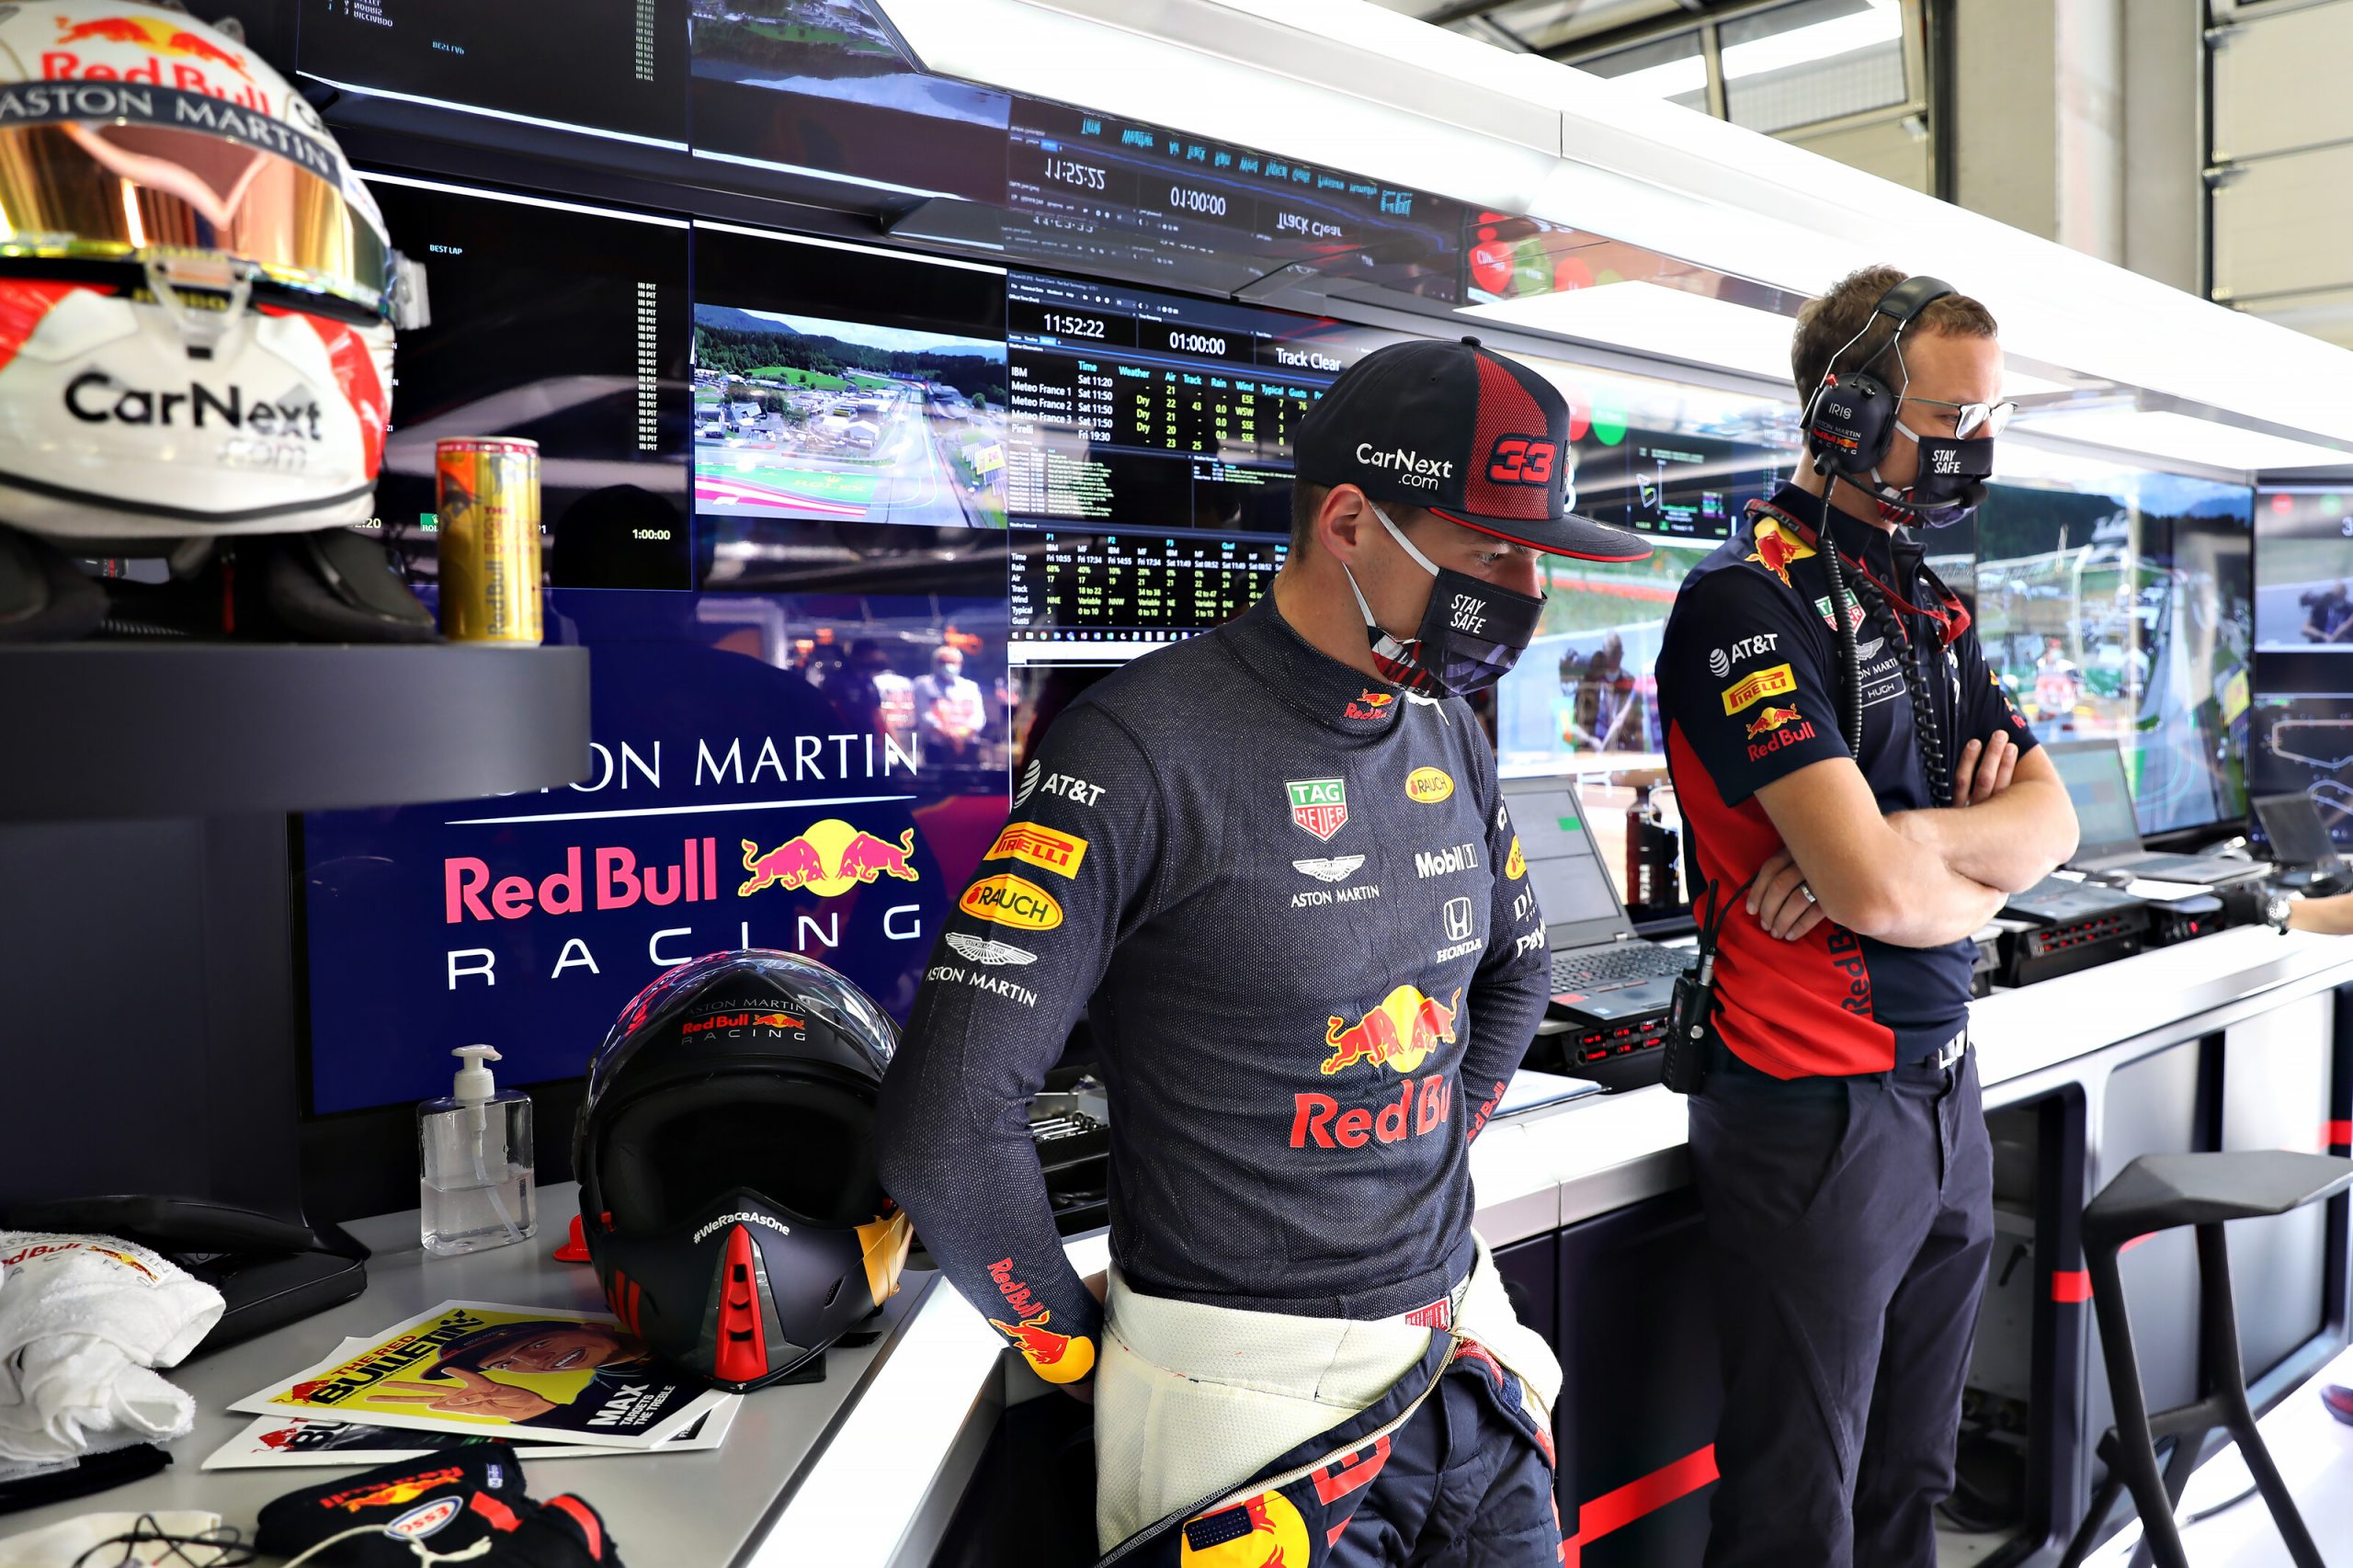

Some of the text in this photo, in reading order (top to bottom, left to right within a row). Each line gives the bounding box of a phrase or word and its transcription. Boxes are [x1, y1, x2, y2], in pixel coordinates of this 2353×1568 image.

[40, 52, 269, 117] Red Bull
[0, 89, 330, 175] ASTON MARTIN
[430, 244, 447, 253] BEST
[1044, 313, 1105, 338] 11:52:22
[1170, 332, 1225, 355] 01:00:00
[1276, 347, 1341, 371] Track Clear
[1012, 367, 1307, 410] IBM Sat 11:20 21 ESE 7 76
[1078, 361, 1307, 398] Time Weather Air Track Rain Wind Typical Gusts
[64, 372, 322, 442] CarNext
[1012, 381, 1038, 392] Meteo
[1040, 384, 1065, 395] France
[1067, 387, 1071, 396] 1
[1078, 389, 1090, 398] Sat
[1093, 391, 1113, 401] 11:50
[1137, 395, 1150, 406] Dry
[1166, 399, 1176, 408] 22
[1192, 402, 1201, 411] 43
[1216, 404, 1226, 414] 0.0
[1235, 407, 1254, 416] WSW
[1012, 395, 1283, 433] Meteo France 2 Sat 11:50 Dry 21 0.0 SSE 3
[1829, 403, 1852, 419] IRIS
[1011, 410, 1284, 446] Meteo France 3 Sat 11:50 Dry 20 0.0 SSE 8
[1011, 424, 1201, 449] Pirelli Fri 19:30 23 25
[1356, 443, 1453, 479] CarNext
[1491, 438, 1557, 483] 33
[1932, 449, 1957, 462] STAY
[1934, 461, 1961, 474] SAFE
[1398, 472, 1438, 491] .com
[632, 529, 670, 540] 1:00:00
[1011, 552, 1027, 561] Time
[486, 560, 505, 636] Red Bull
[1012, 607, 1032, 616] Typical
[1450, 594, 1486, 615] STAY
[1450, 611, 1486, 634] SAFE
[1731, 633, 1778, 664] AT&T
[1730, 671, 1787, 709] PIRELLI
[1867, 683, 1895, 699] HUGH
[1344, 702, 1374, 720] Red
[695, 732, 917, 786] MARTIN
[1747, 722, 1816, 763] Red Bull
[1040, 773, 1106, 807] AT&T
[1291, 783, 1341, 803] TAG
[1417, 776, 1448, 794] RAUCH
[1294, 805, 1346, 840] HEUER
[995, 829, 1074, 867] PIRELLI
[1415, 846, 1464, 879] Mobil
[445, 837, 717, 924] Red Bull
[1290, 884, 1380, 908] ASTON MARTIN
[981, 886, 1049, 923] RAUCH
[448, 903, 919, 990] RACING
[1436, 937, 1483, 963] HONDA
[926, 966, 1037, 1007] ASTON MARTIN
[1834, 956, 1871, 1016] Red
[687, 999, 806, 1015] ASTON MARTIN
[682, 1014, 749, 1035] Red Bull
[682, 1028, 806, 1045] RACING
[1290, 1078, 1415, 1149] Red
[694, 1211, 790, 1244] #WeRaceAsOne
[28, 1243, 82, 1258] Bull
[987, 1257, 1044, 1318] Red Bull
[311, 1310, 485, 1405] BULLETIN
[331, 1335, 418, 1376] THE RED
[586, 1384, 650, 1426] MAX
[620, 1394, 654, 1426] TARGETS
[633, 1385, 676, 1426] THE TREBLE
